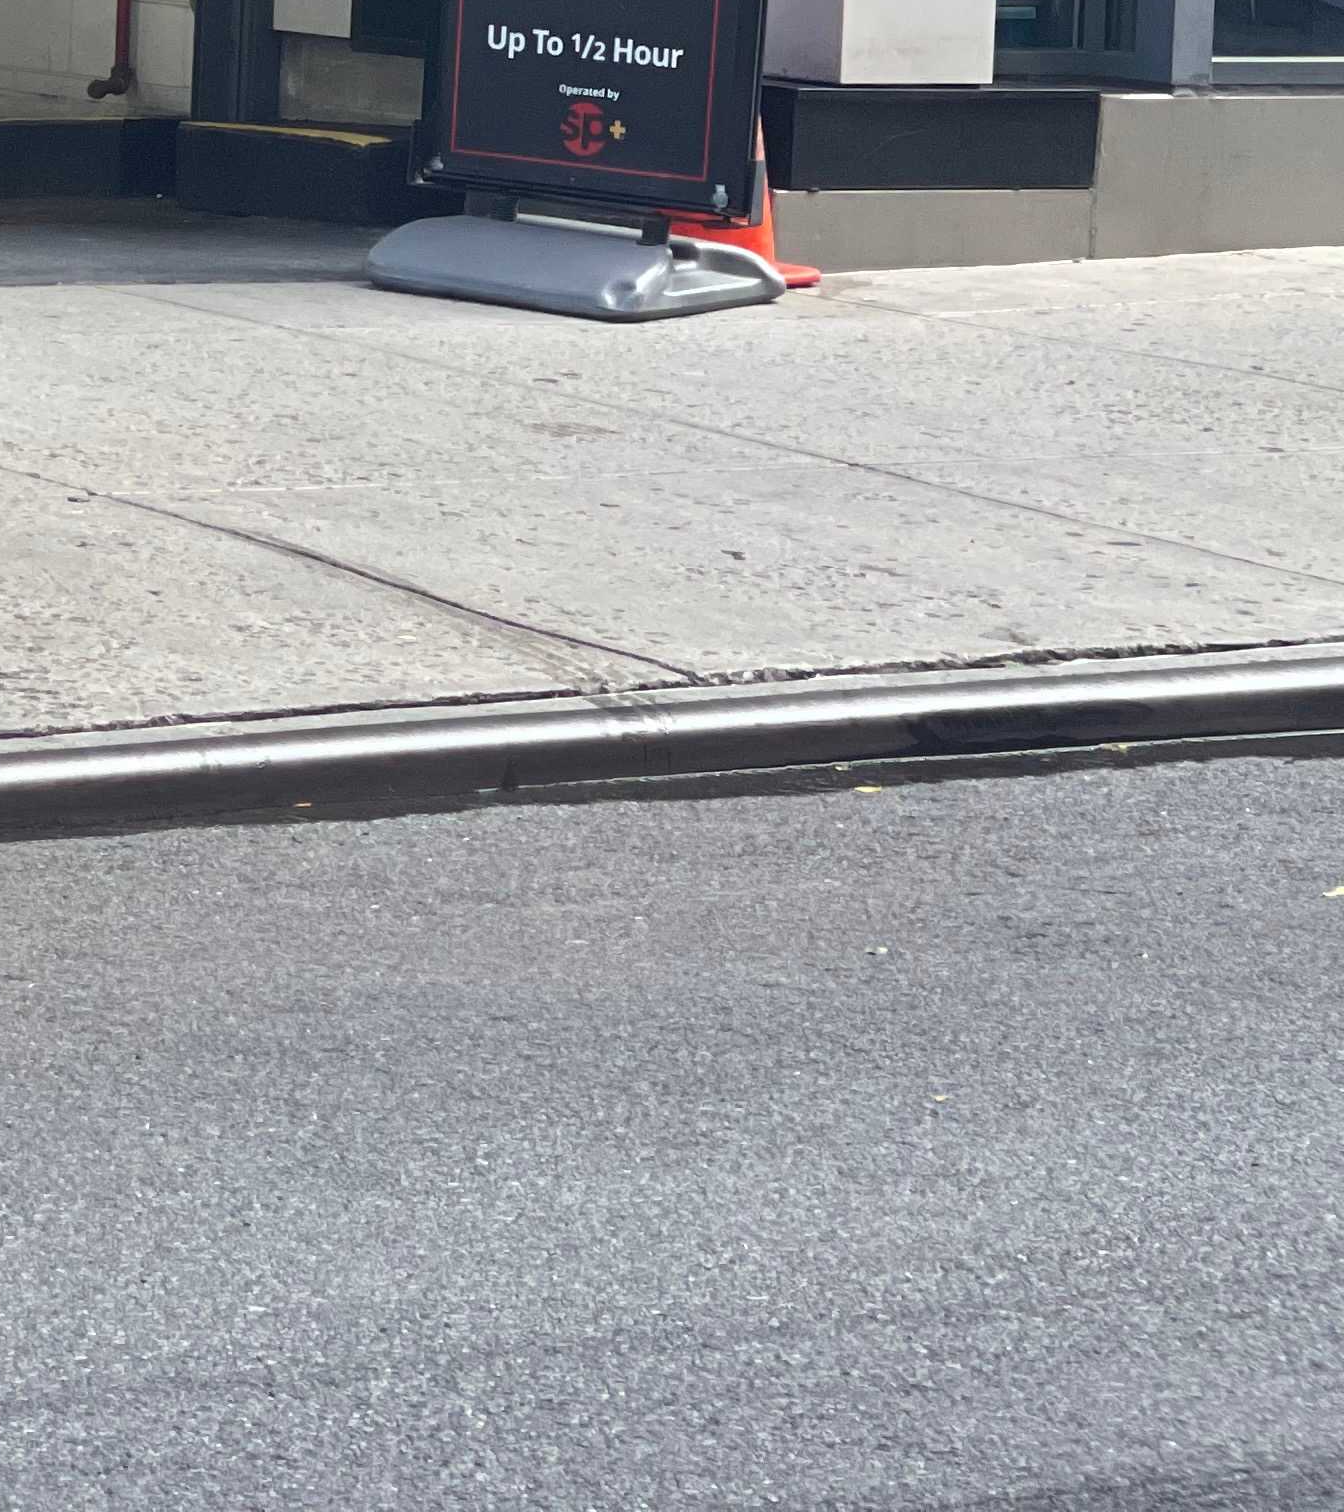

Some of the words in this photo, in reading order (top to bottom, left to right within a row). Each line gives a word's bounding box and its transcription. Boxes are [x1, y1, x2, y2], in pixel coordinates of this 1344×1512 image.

[486, 24, 526, 58] Up
[532, 28, 564, 56] To
[613, 38, 684, 69] Hour
[558, 83, 603, 100] Operated
[605, 87, 620, 102] by
